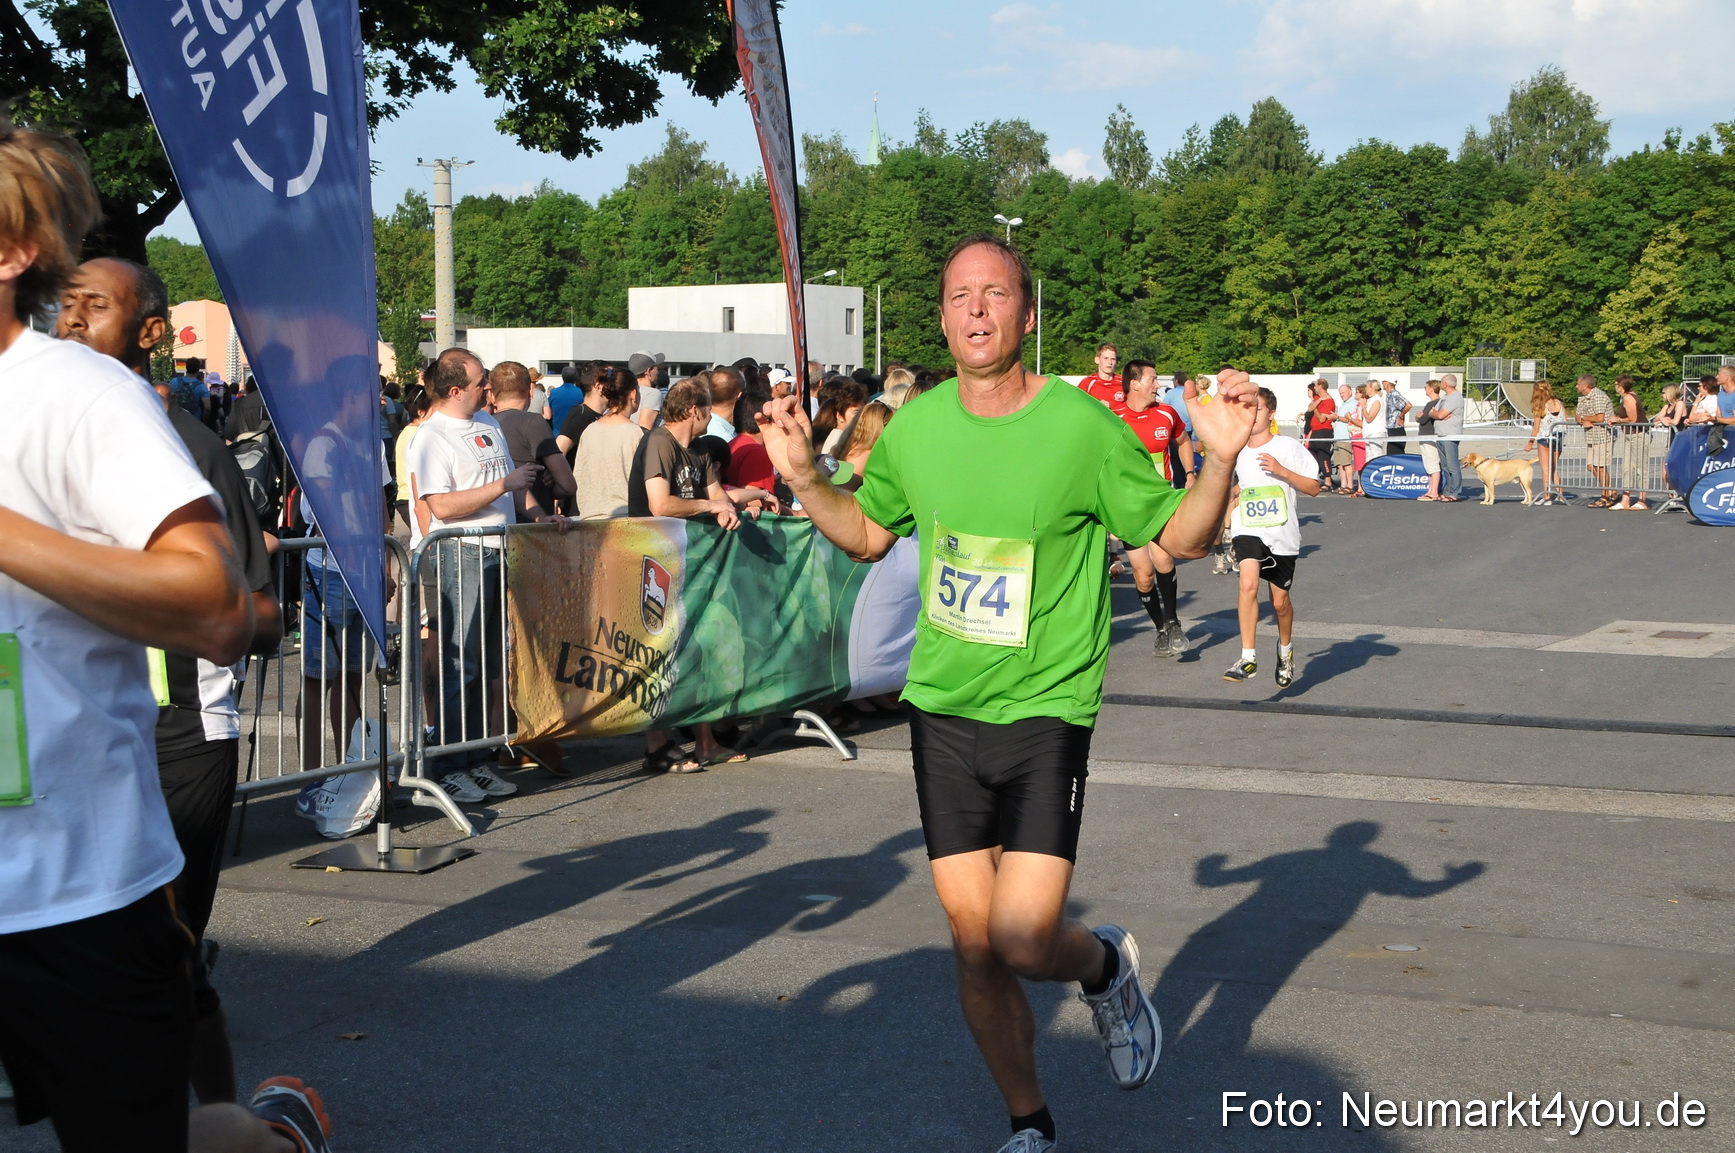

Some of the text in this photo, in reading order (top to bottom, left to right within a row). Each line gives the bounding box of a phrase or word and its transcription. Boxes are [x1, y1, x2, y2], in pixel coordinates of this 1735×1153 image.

[1246, 499, 1279, 517] 894
[938, 565, 1010, 617] 574
[931, 613, 947, 624] Kliniken
[955, 622, 986, 634] Landkreises
[988, 629, 1017, 637] Neumarkt
[949, 611, 991, 625] Martin Drechsel
